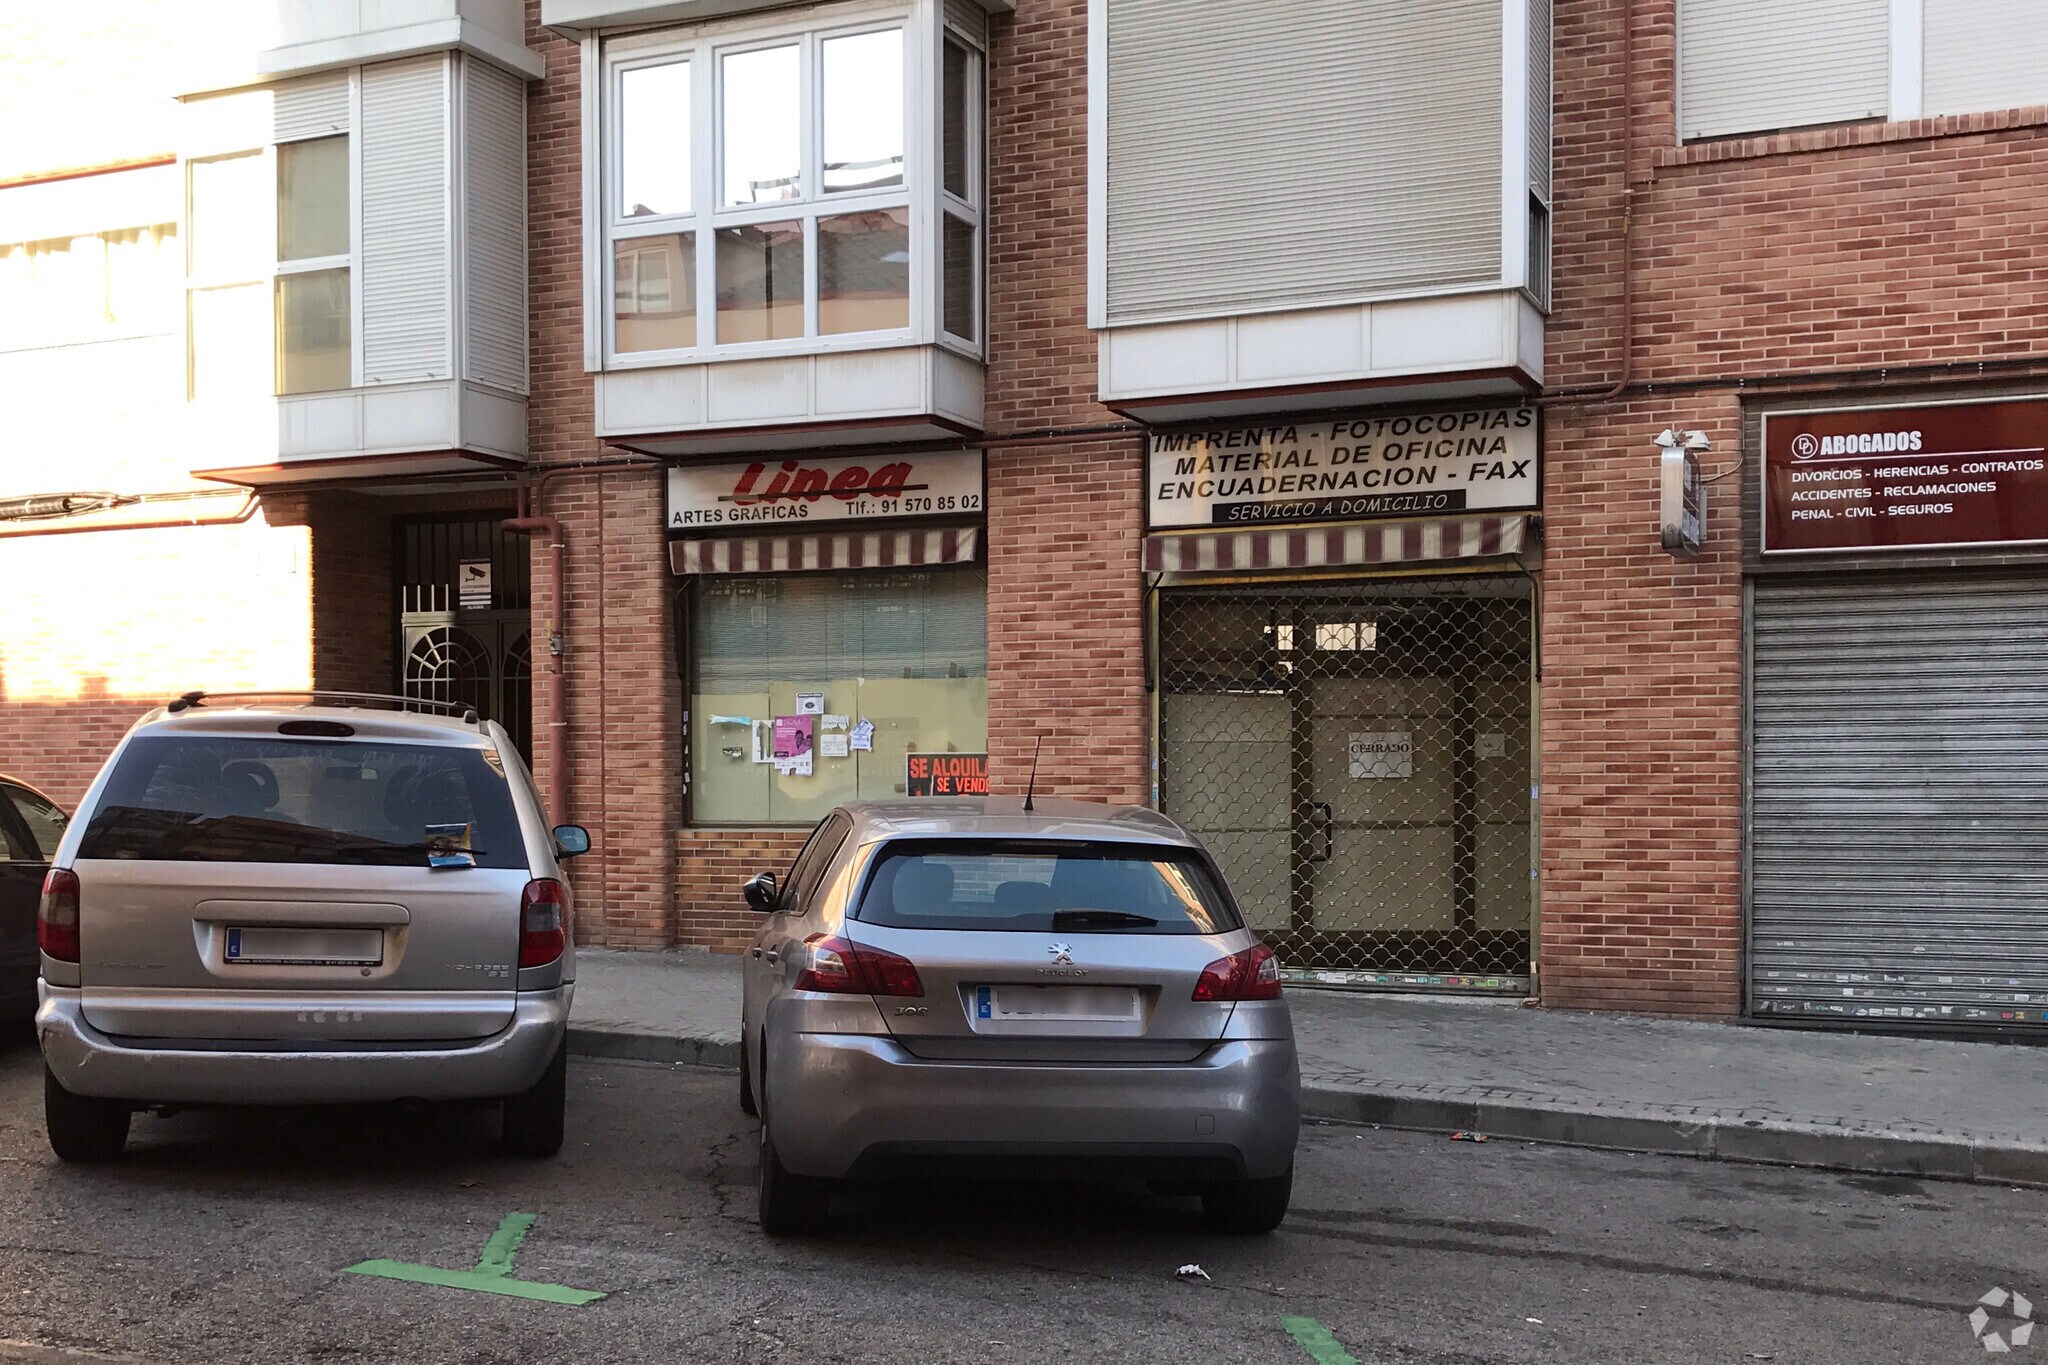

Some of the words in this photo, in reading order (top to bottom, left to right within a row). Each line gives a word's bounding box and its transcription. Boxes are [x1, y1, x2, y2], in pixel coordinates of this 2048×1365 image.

[1154, 426, 1299, 453] IMPRENTA
[1331, 408, 1533, 440] FOTOCOPIAS
[1820, 431, 1922, 455] ABOGADOS
[1174, 448, 1319, 475] MATERIAL
[1331, 445, 1372, 465] DE
[1382, 436, 1507, 463] OFICINA
[1158, 465, 1438, 500] ENCUADERNACION
[1468, 459, 1531, 482] FAX
[1792, 469, 1862, 482] DIVORCIOS
[1874, 465, 1949, 478] HERENCIAS
[1961, 459, 2044, 474] CONTRATOS
[1791, 488, 1872, 501] ACCIDENTES
[1884, 482, 1996, 497] RECLAMACIONES
[672, 510, 722, 524] ARTES
[728, 504, 808, 522] GRAFICAS
[882, 499, 898, 513] 91
[905, 497, 931, 512] 570
[937, 496, 955, 510] 85
[961, 495, 979, 509] 02
[1228, 502, 1316, 521] SERVICIO
[1322, 500, 1334, 514] A
[1340, 494, 1447, 514] DOMICILIO
[1792, 509, 1834, 520] PENAL
[1845, 507, 1876, 518] CIVIL
[1888, 503, 1953, 516] SEGUROS
[1351, 743, 1409, 753] CERRADO
[910, 758, 928, 778] SE
[937, 777, 950, 792] SE
[1035, 968, 1089, 976] PEUGEOT
